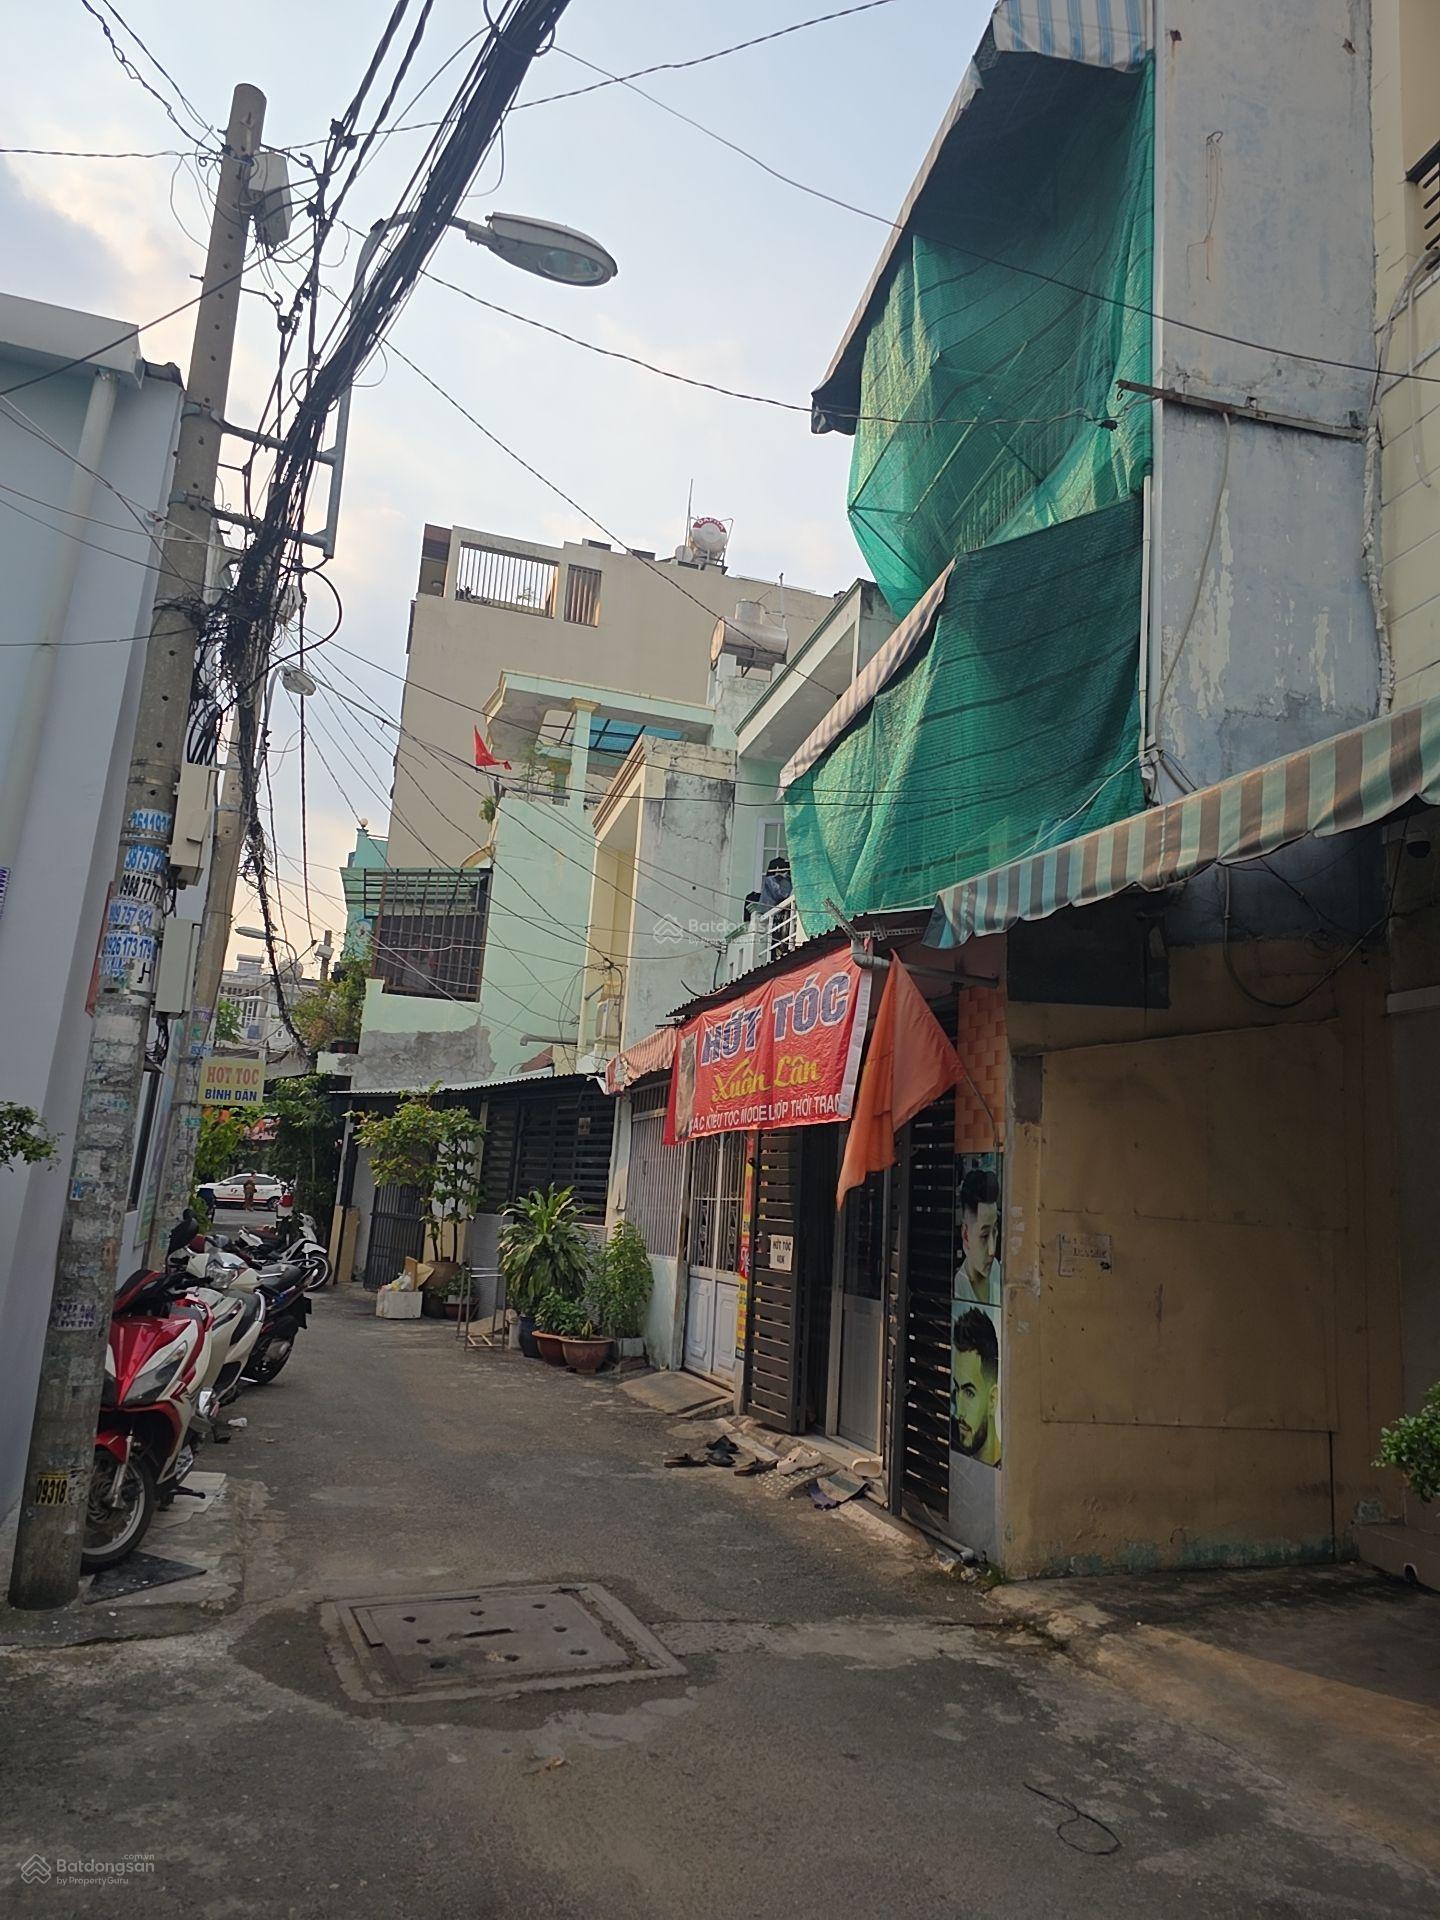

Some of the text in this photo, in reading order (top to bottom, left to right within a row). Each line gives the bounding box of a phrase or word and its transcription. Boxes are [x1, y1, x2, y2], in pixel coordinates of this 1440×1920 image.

[123, 937, 138, 957] 173
[772, 971, 851, 1043] TÓC
[711, 1054, 822, 1102] Xuân Lân
